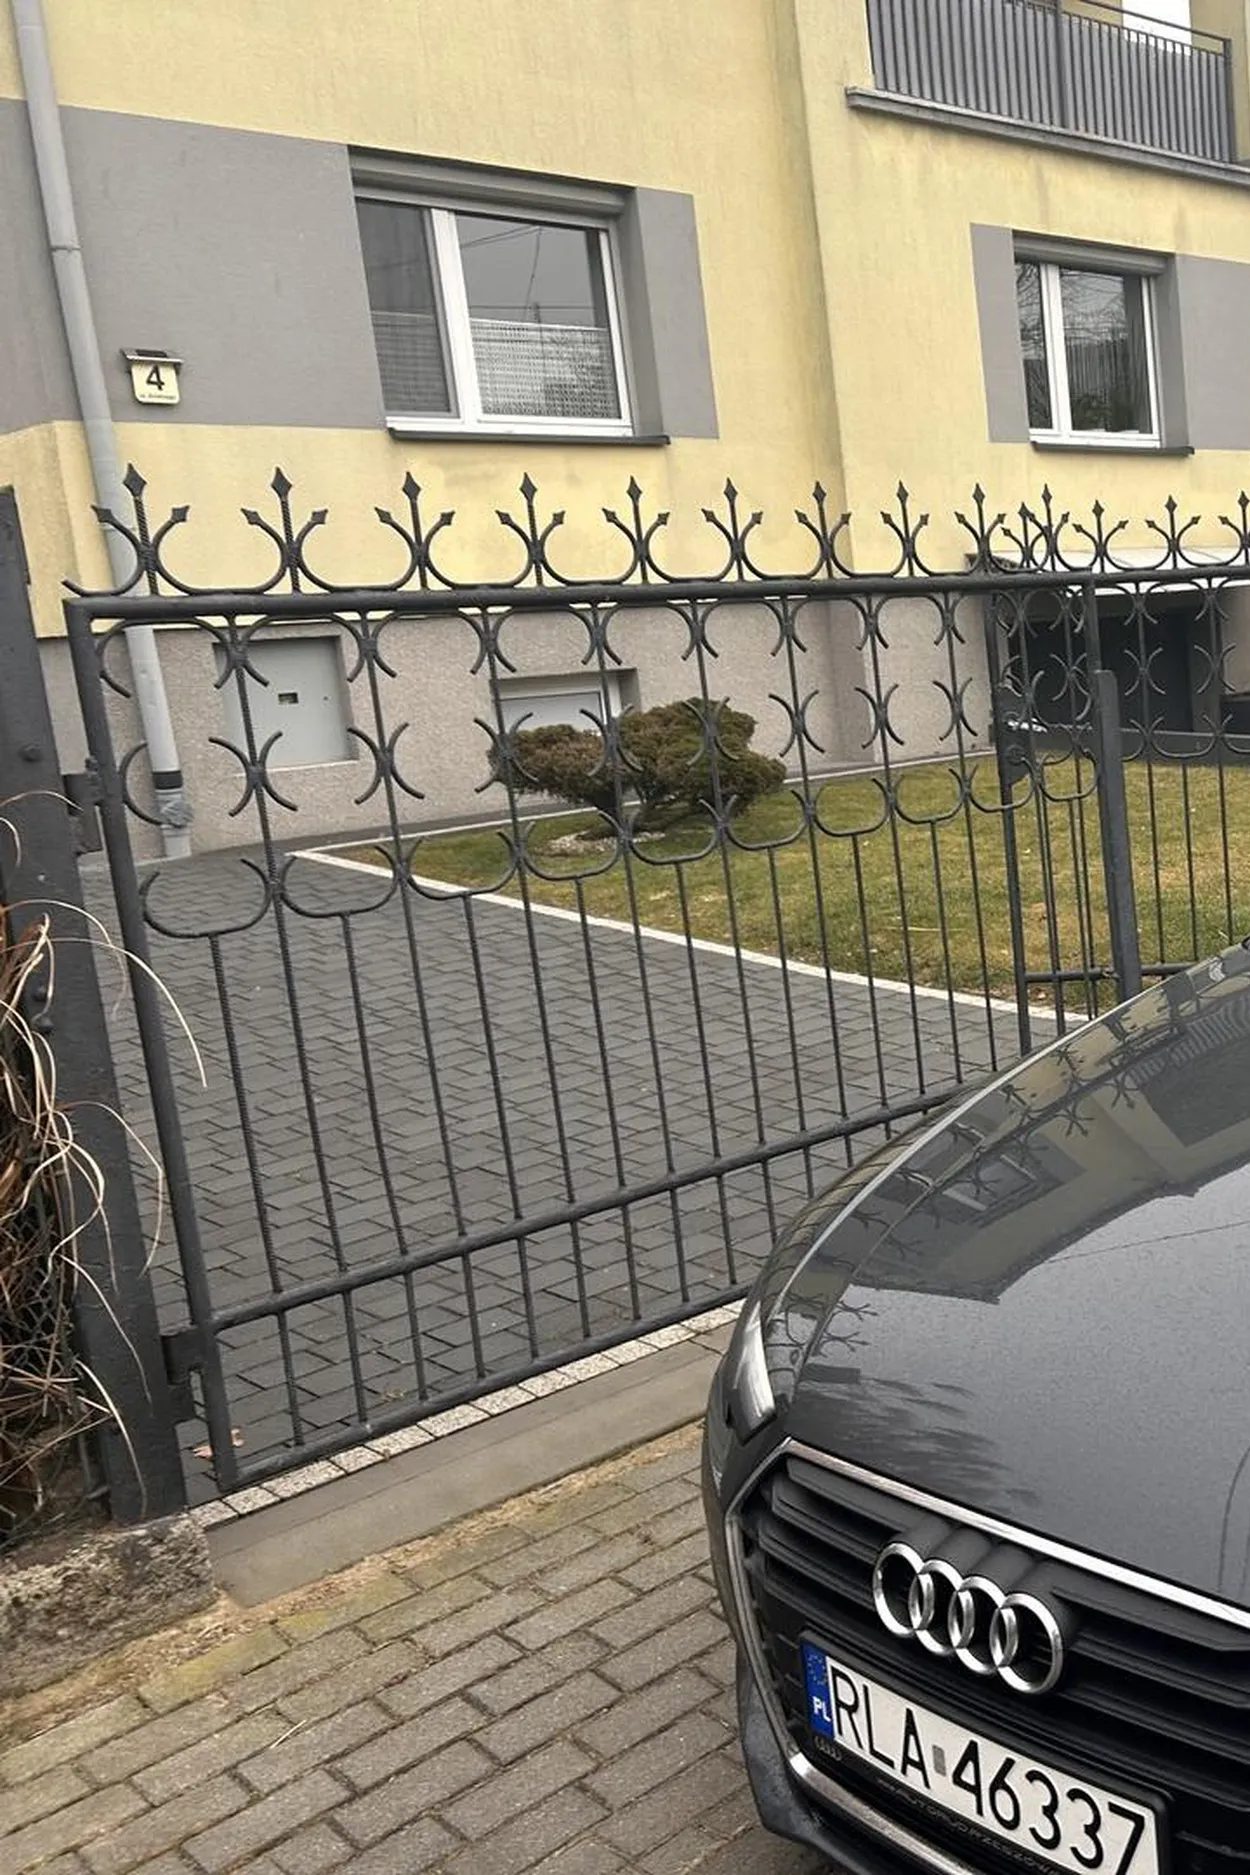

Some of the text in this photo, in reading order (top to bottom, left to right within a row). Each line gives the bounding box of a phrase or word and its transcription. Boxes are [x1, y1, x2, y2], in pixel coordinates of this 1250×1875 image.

[146, 365, 165, 391] 4
[813, 1695, 831, 1722] PL
[830, 1666, 1145, 1875] RLA 46337
